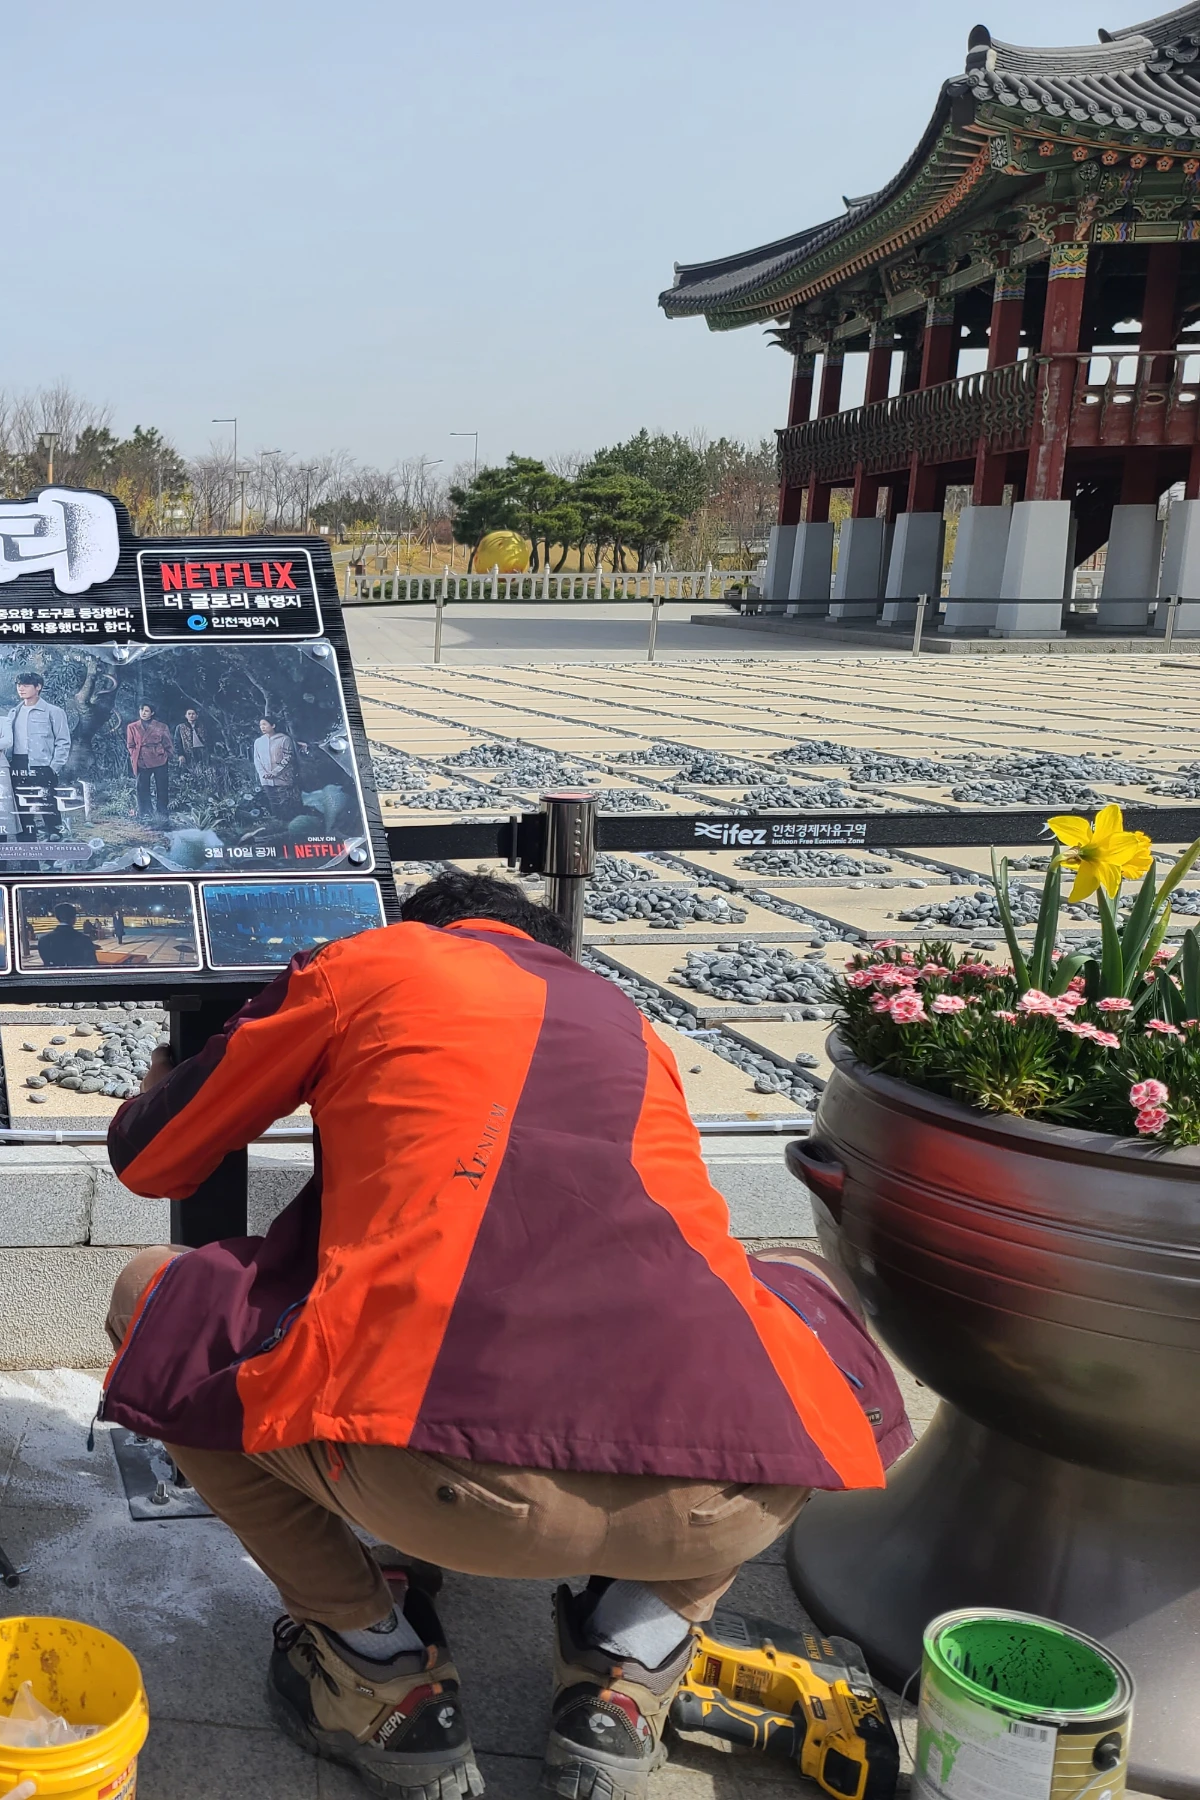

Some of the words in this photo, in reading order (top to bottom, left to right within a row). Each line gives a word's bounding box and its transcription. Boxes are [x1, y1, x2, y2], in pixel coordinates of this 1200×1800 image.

[161, 562, 297, 592] NETFLIX
[163, 593, 183, 609] 더
[189, 593, 250, 609] 글로리
[254, 594, 302, 609] 촬영지
[36, 608, 76, 619] 도구로
[79, 607, 134, 619] 등장한다.
[30, 621, 99, 634] 적용했다고
[104, 621, 135, 633] 한다.
[211, 616, 279, 628] 인천광역시
[11, 769, 37, 777] 시리즈
[722, 823, 767, 845] ifez
[771, 823, 867, 838] 인천경제자유구역
[204, 847, 224, 859] 3월
[227, 847, 253, 859] 10일
[255, 847, 277, 858] 공개
[378, 1711, 407, 1741] NEPA
